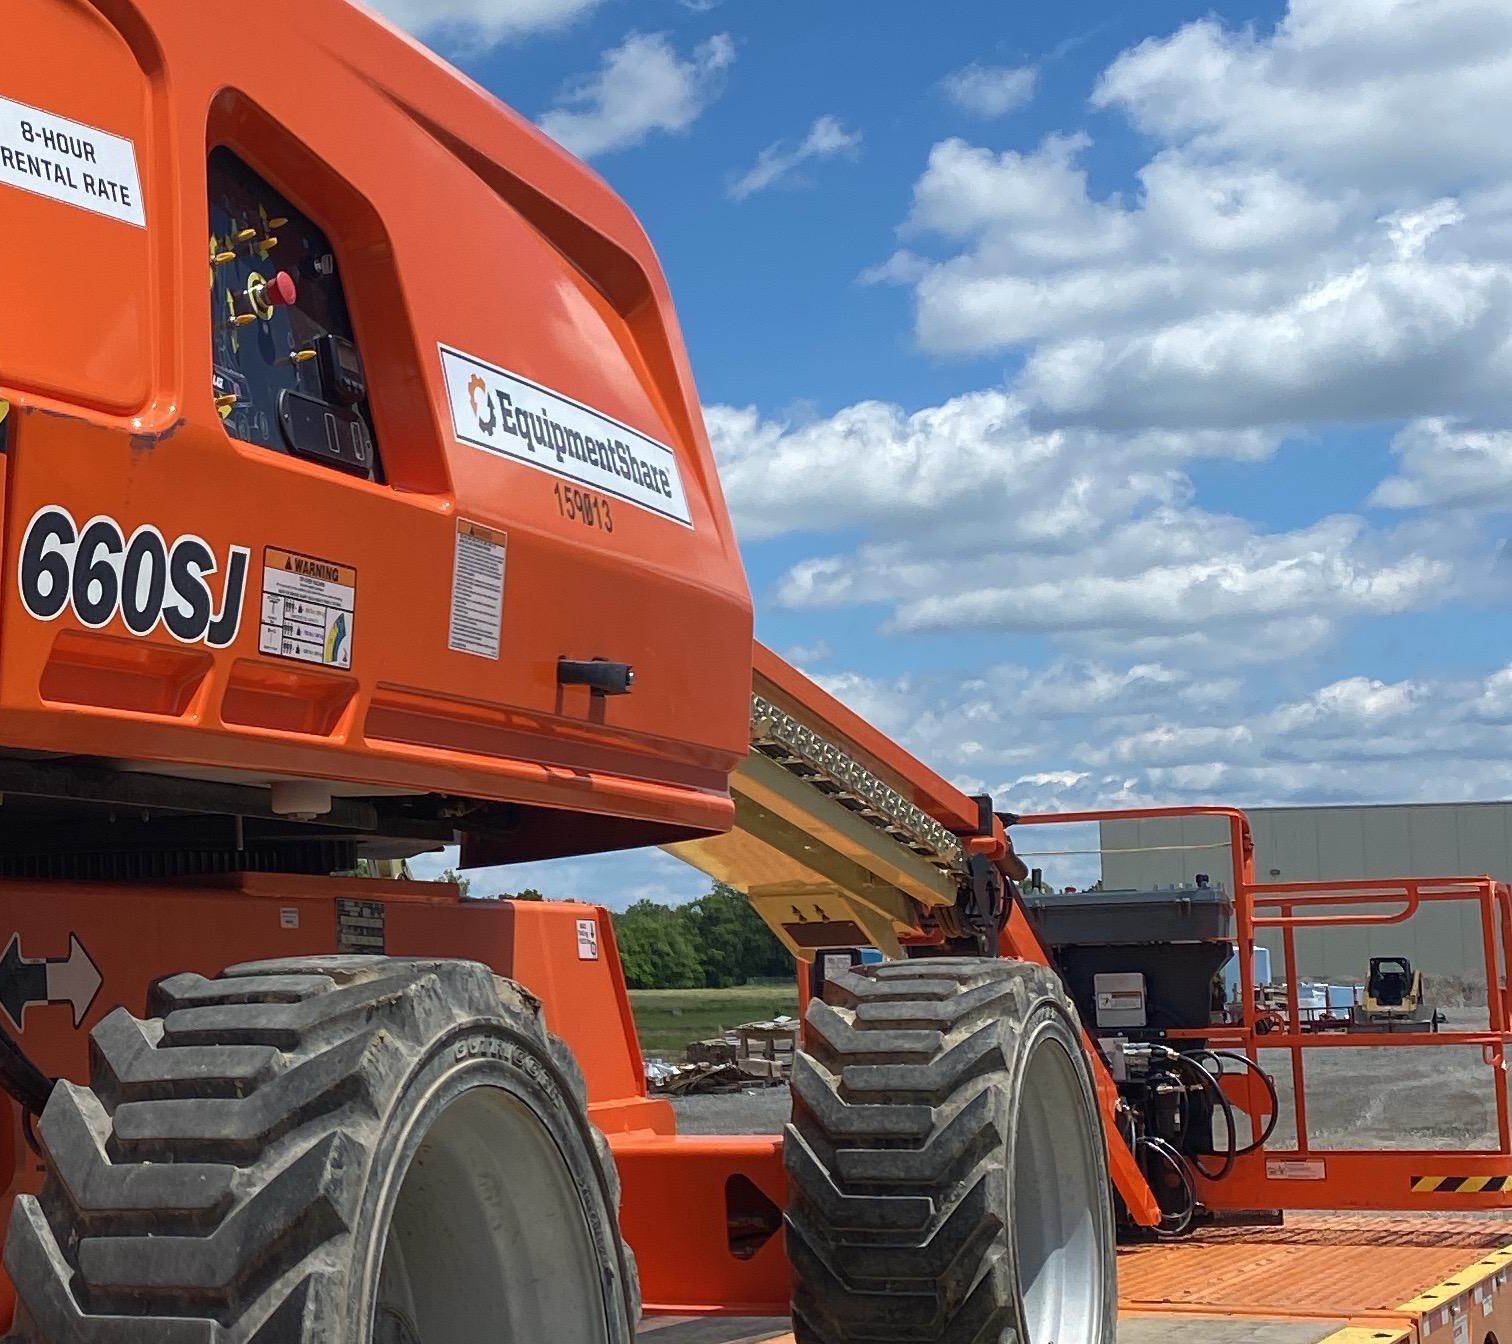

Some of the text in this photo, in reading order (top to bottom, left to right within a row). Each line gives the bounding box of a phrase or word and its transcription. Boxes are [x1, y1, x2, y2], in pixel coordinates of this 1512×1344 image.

[20, 120, 97, 164] 8-HOUR
[0, 145, 132, 207] RENTAL RATE
[495, 388, 673, 500] EquipmentShare
[21, 510, 249, 646] 660SJ
[294, 557, 339, 582] WARNING
